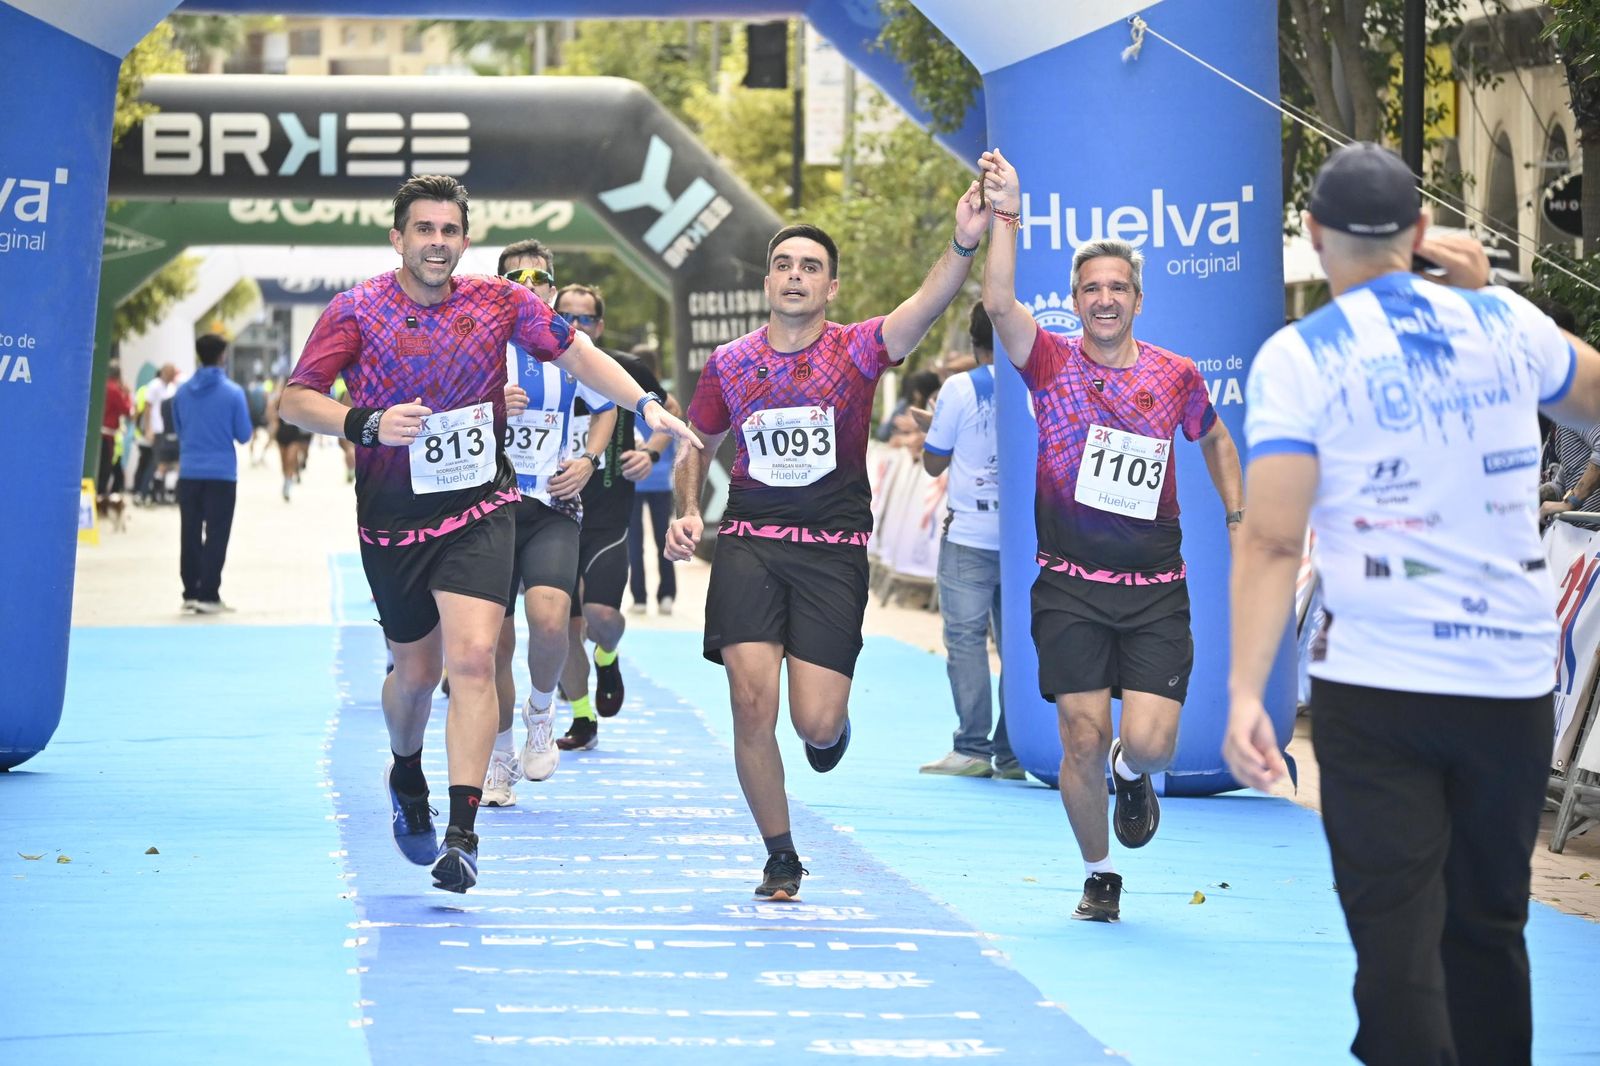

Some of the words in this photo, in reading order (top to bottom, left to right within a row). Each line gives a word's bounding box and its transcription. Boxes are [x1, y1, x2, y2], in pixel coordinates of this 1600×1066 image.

[1022, 189, 1240, 250] Huelva
[1167, 251, 1240, 279] original
[18, 333, 35, 349] de
[1226, 354, 1243, 371] de
[545, 413, 558, 424] 2K
[748, 413, 766, 426] 2K
[504, 426, 550, 451] 937
[751, 427, 831, 457] 1093
[1095, 429, 1113, 444] 2K
[425, 428, 485, 463] 813
[1155, 443, 1167, 456] 2K
[437, 471, 476, 485] Huelva
[771, 470, 809, 480] Huelva
[1091, 449, 1162, 490] 1103
[1098, 492, 1137, 510] Huelva
